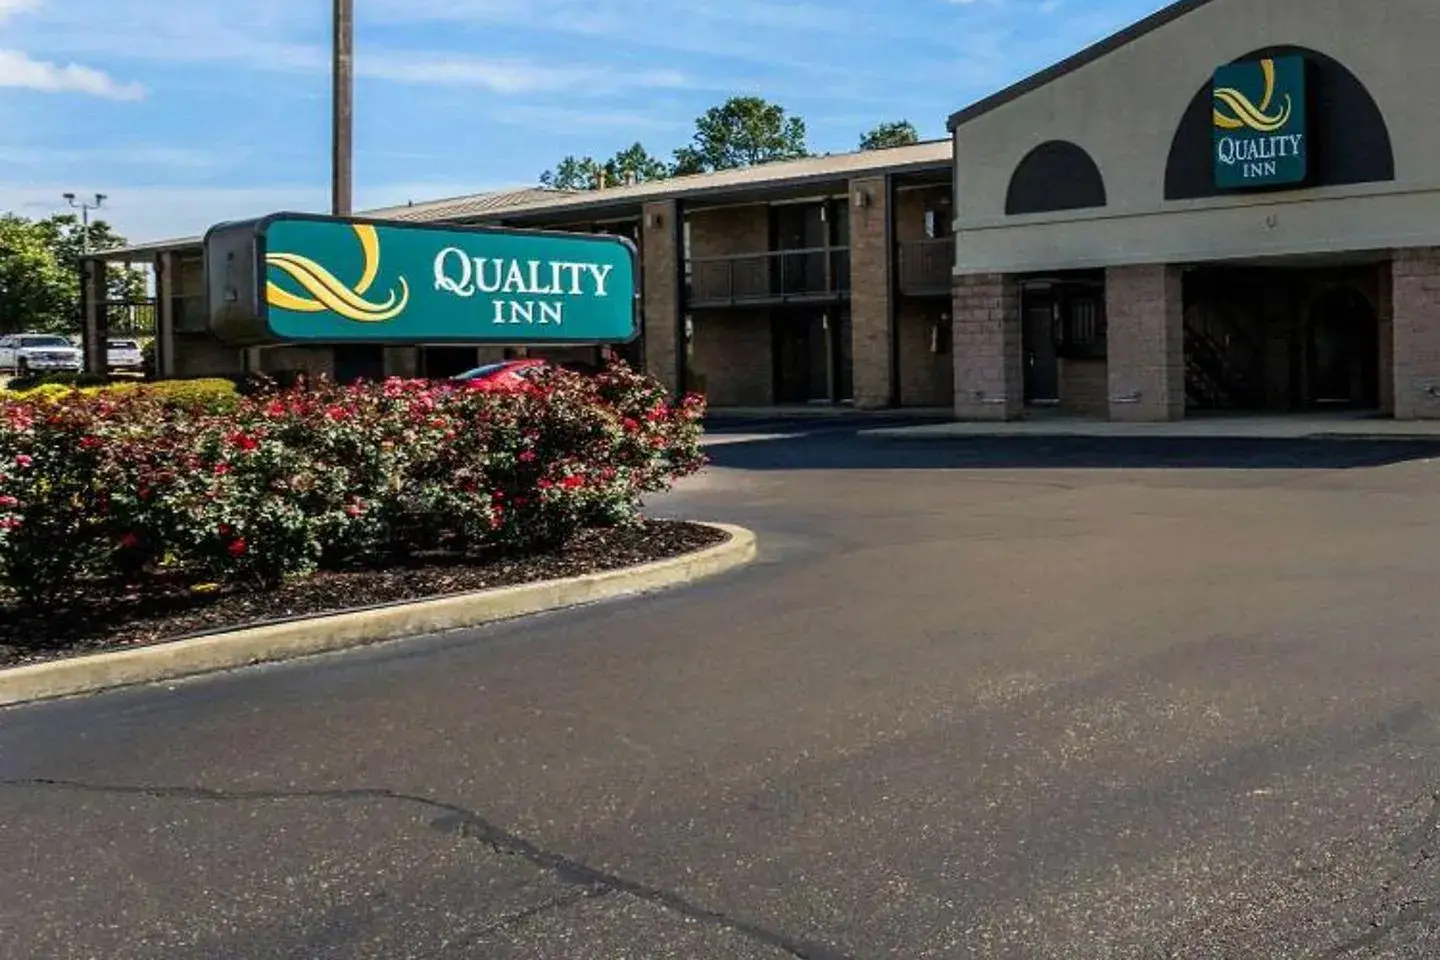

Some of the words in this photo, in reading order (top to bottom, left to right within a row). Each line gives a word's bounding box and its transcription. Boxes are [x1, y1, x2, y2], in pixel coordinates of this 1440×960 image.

[1218, 134, 1302, 164] QUALITY
[1243, 161, 1276, 177] INN
[433, 247, 613, 297] QUALITY
[493, 300, 563, 325] INN
